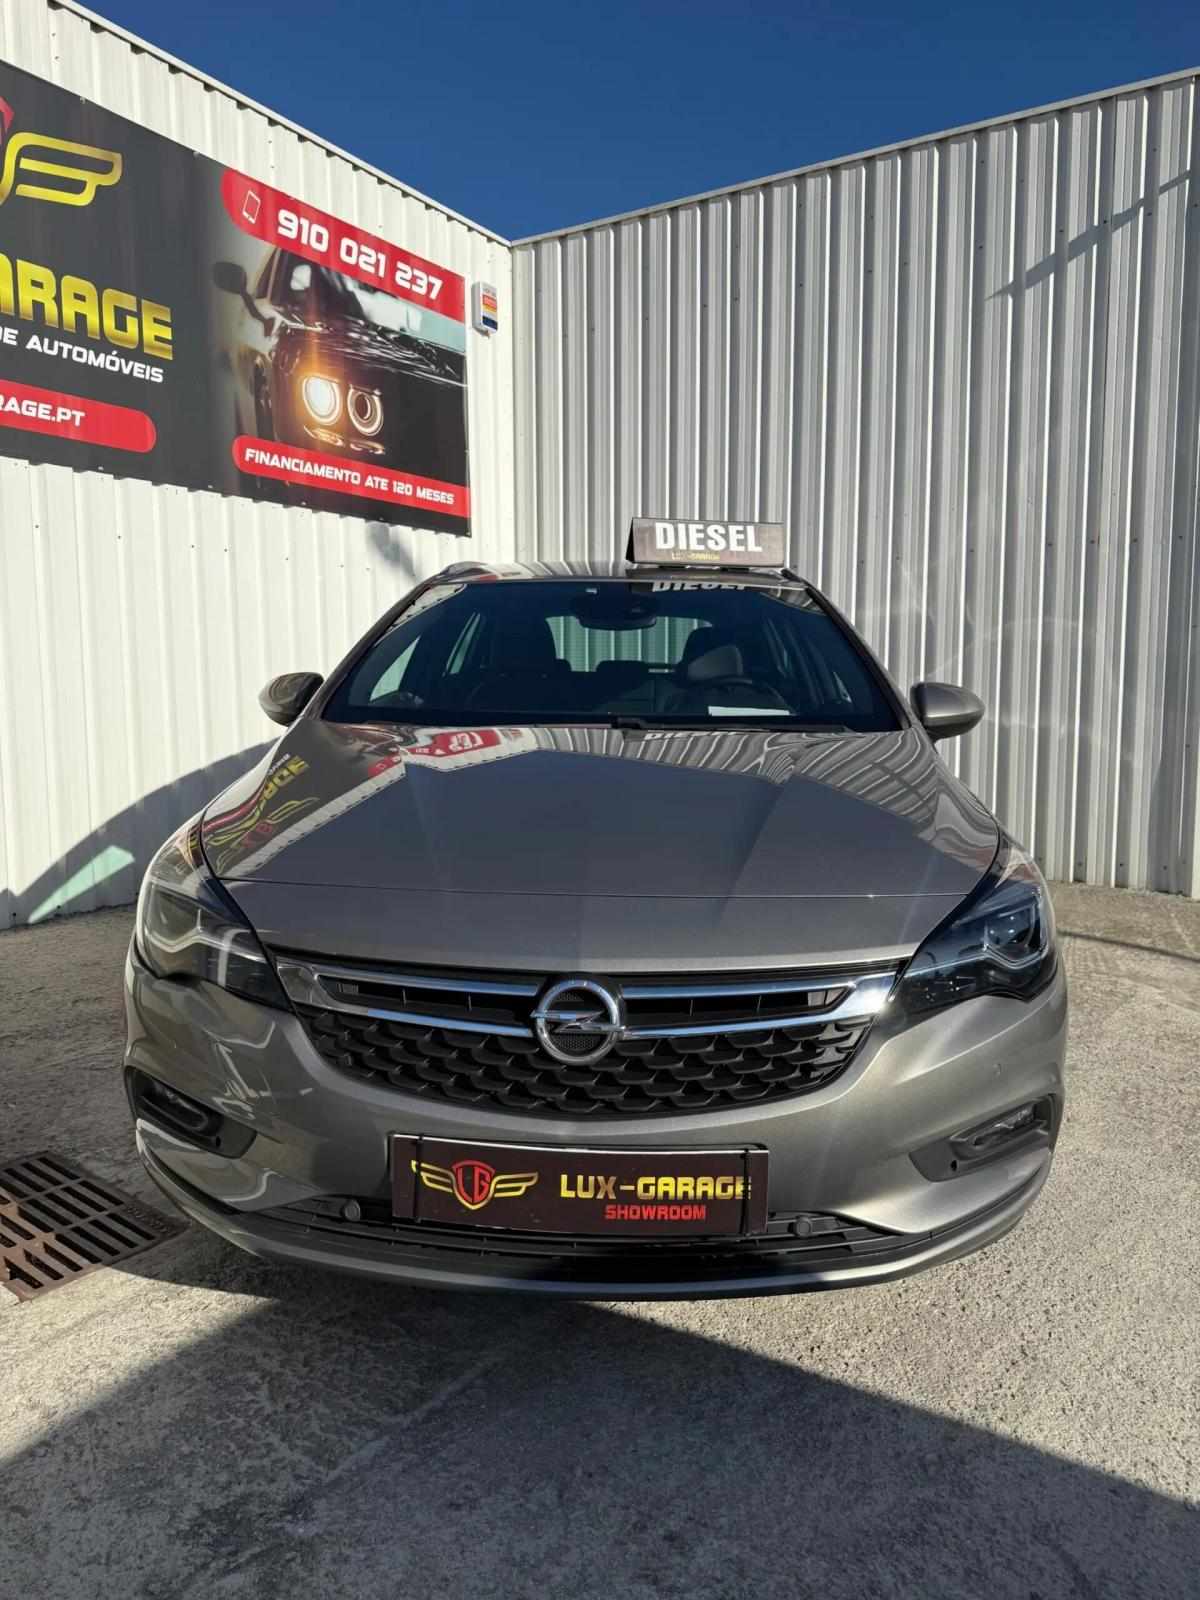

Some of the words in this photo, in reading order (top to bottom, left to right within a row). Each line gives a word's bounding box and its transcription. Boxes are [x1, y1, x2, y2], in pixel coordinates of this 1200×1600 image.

[277, 209, 330, 253] 910
[339, 237, 387, 278] 021
[395, 261, 443, 300] 237
[0, 326, 19, 346] E
[25, 334, 164, 384] AUTOMÓVEIS
[244, 447, 361, 486] FINANCIAMENTO
[364, 475, 389, 492] ATE
[392, 479, 413, 497] 120
[415, 486, 455, 505] MESES
[655, 522, 763, 553] DIESEL
[560, 1174, 752, 1200] LUX-GARAGE
[605, 1204, 707, 1221] SHOWROOM
